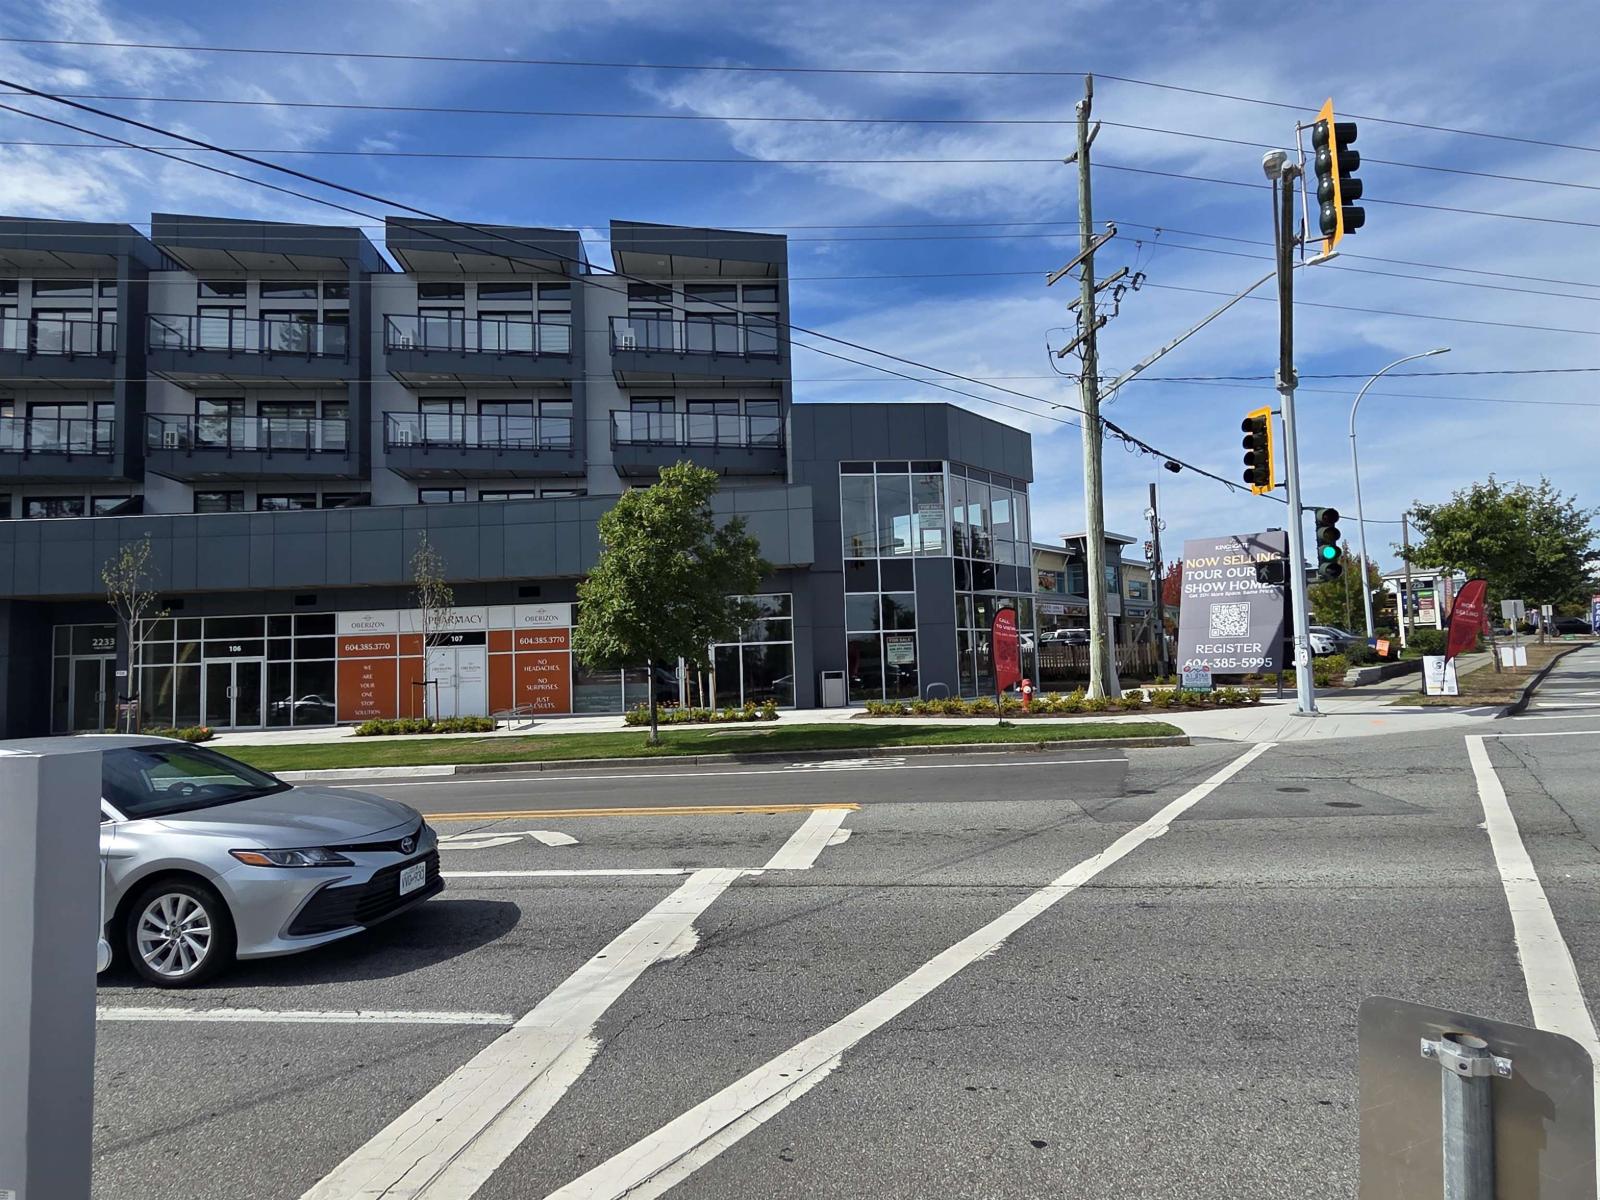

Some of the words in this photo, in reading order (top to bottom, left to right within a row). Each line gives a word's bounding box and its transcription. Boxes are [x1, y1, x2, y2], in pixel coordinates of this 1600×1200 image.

[1186, 557, 1220, 568] NOW
[1223, 552, 1281, 566] SELLING
[1185, 569, 1222, 580] TOUR
[1226, 567, 1256, 578] OUR
[1184, 581, 1227, 594] SHOW
[428, 615, 483, 625] PHARMACY
[92, 638, 115, 646] 2233
[520, 636, 565, 645] 604.385.3770
[345, 643, 391, 651] 604.385.3770
[1195, 643, 1262, 654] REGISTER
